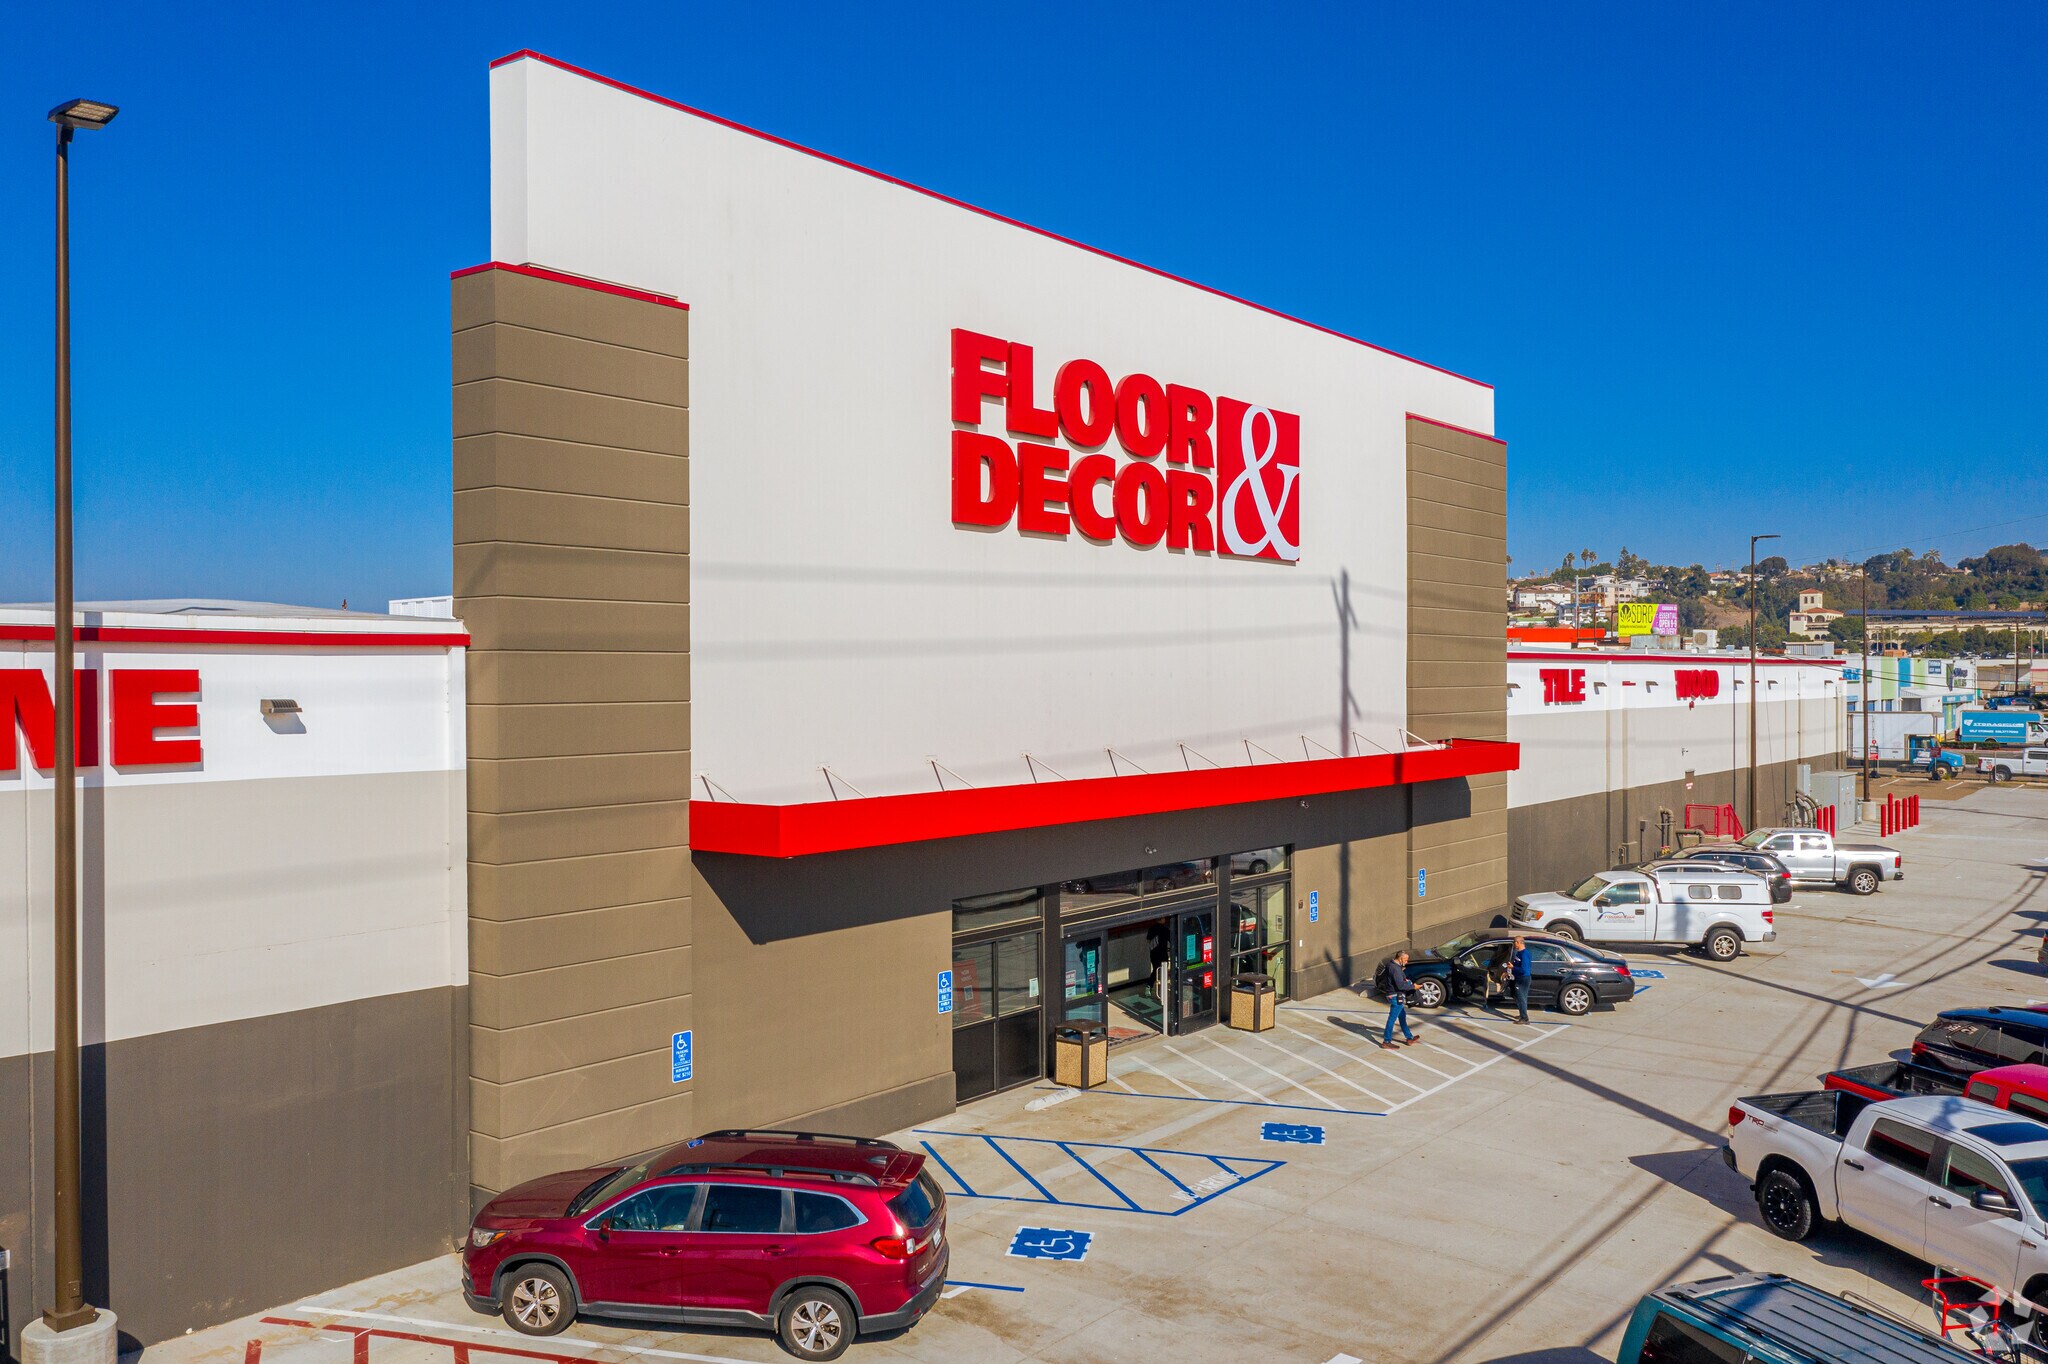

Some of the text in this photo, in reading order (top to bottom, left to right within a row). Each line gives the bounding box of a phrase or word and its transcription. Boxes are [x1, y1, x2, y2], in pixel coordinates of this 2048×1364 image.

[951, 328, 1215, 468] FLOOR
[951, 429, 1215, 552] DECOR
[1221, 403, 1300, 561] &
[1631, 604, 1654, 624] SDRC
[1659, 619, 1670, 628] OPEN
[1539, 669, 1586, 703] TILE
[1674, 669, 1720, 699] WOOD
[0, 669, 201, 770] NE
[1747, 1114, 1765, 1127] TRD
[1187, 1171, 1242, 1194] PARKING
